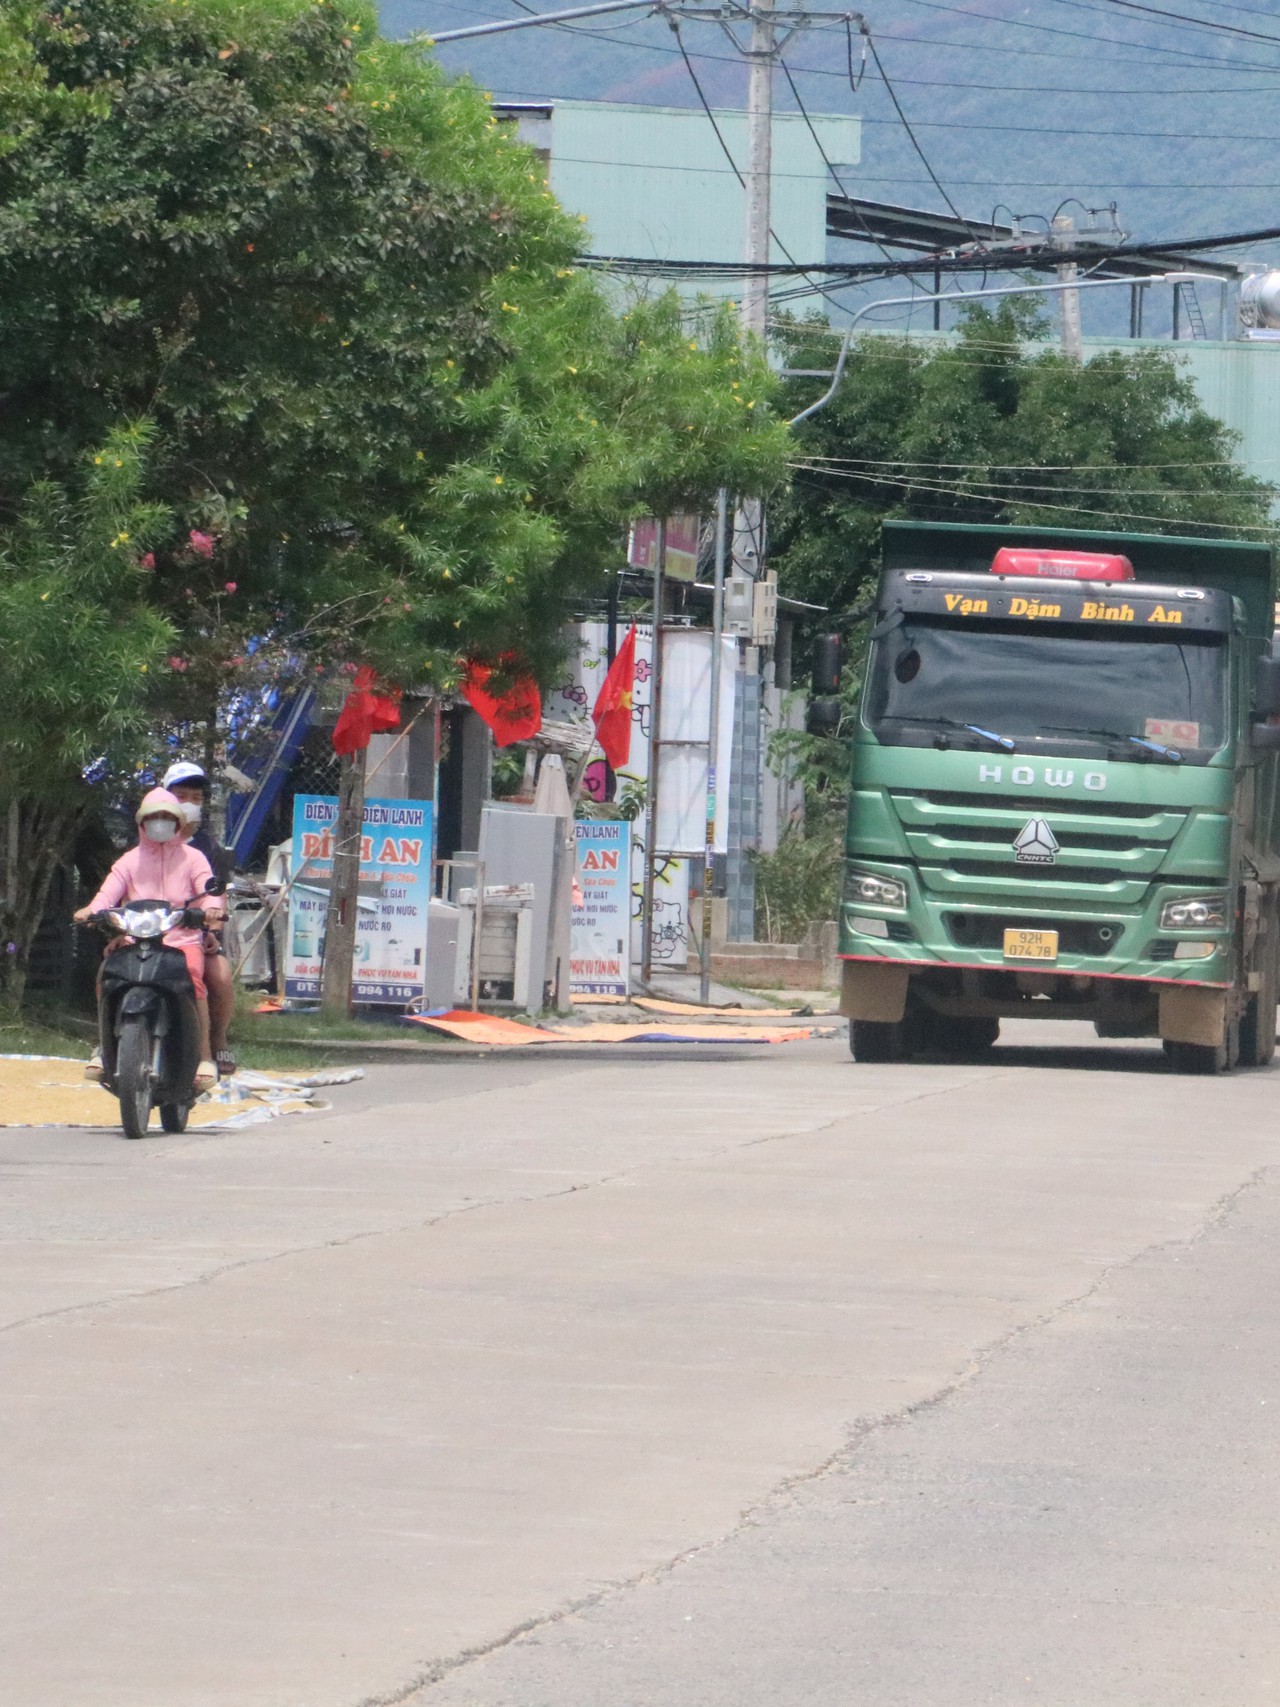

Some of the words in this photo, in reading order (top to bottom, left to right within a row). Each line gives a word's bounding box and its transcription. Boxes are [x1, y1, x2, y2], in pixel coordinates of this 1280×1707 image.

[1037, 562, 1078, 577] Haier
[945, 594, 987, 616] Vạn
[1008, 598, 1061, 620] Dặm
[1080, 603, 1134, 622] Bình
[1148, 606, 1182, 624] An
[979, 764, 1107, 791] HOWO
[379, 839, 420, 863] AN
[583, 850, 619, 870] AN
[1020, 932, 1043, 944] 92H
[1009, 944, 1052, 958] 074.78
[357, 985, 383, 996] 994
[387, 987, 412, 997] 116
